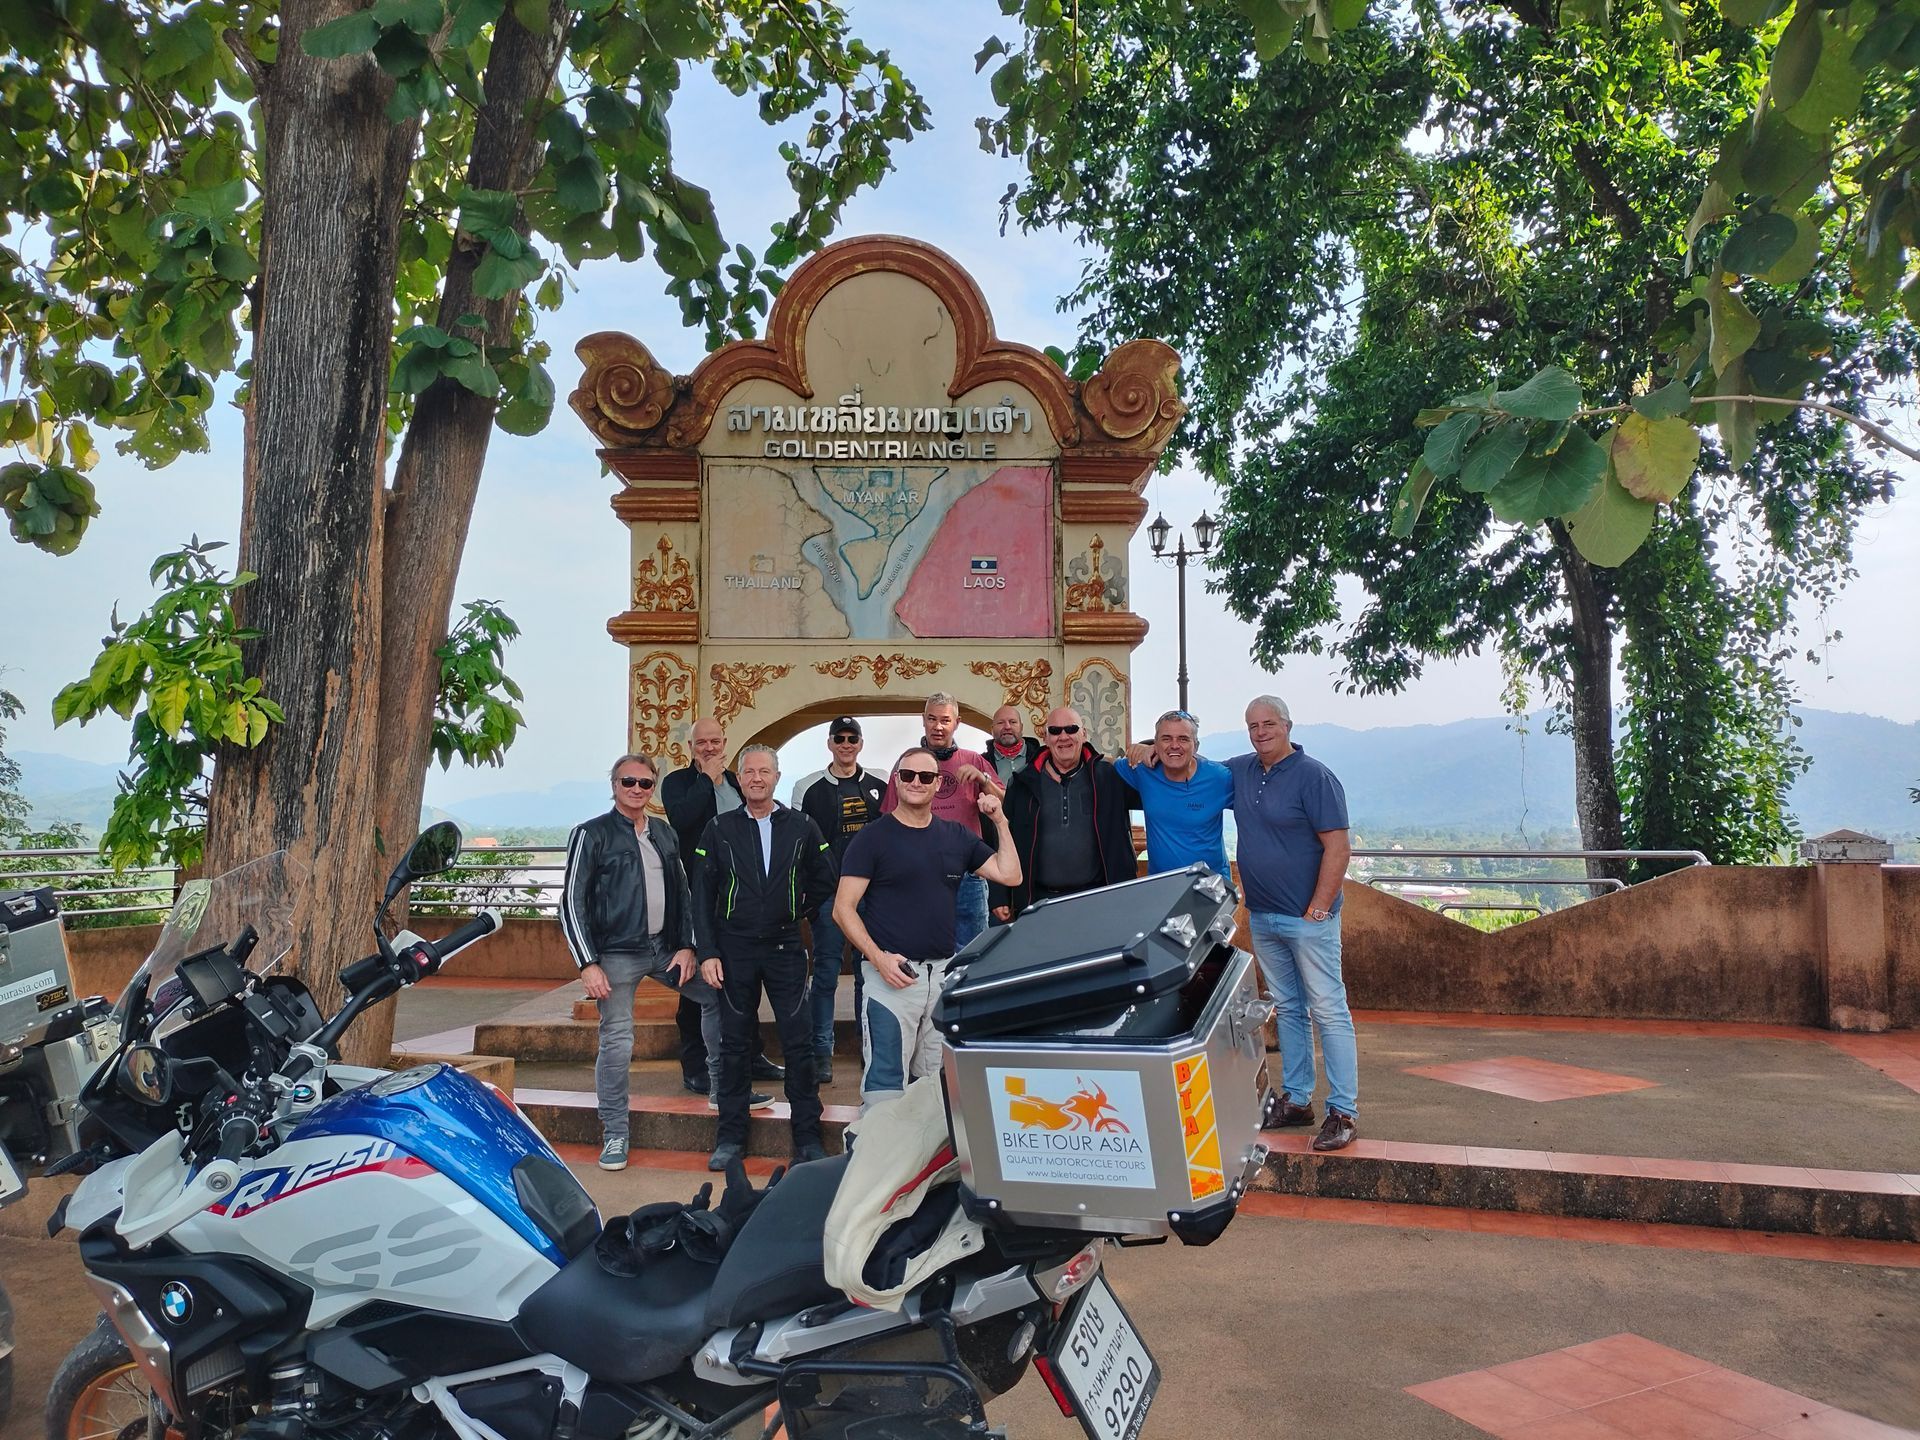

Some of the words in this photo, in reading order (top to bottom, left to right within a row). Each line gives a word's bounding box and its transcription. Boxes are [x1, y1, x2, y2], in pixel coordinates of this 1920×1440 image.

[727, 383, 1032, 433] สามเหลี่ยมทองคำ
[843, 491, 919, 503] MYANAR
[725, 576, 801, 589] THAILAND
[963, 576, 1006, 589] LAOS
[1003, 1132, 1039, 1148] BIKE
[1043, 1134, 1093, 1151] TOUR
[1099, 1136, 1143, 1153] ASIA
[1006, 1154, 1043, 1166] QUALITY
[1046, 1157, 1113, 1169] MOTORCYCLE
[1114, 1160, 1146, 1171] TOURS
[1027, 1169, 1128, 1182] www.biketourasia.com
[223, 1172, 281, 1219] R
[288, 1198, 483, 1300] GS
[1085, 1322, 1128, 1416] กรุงเทพมหานคร
[1105, 1356, 1143, 1438] 9290
